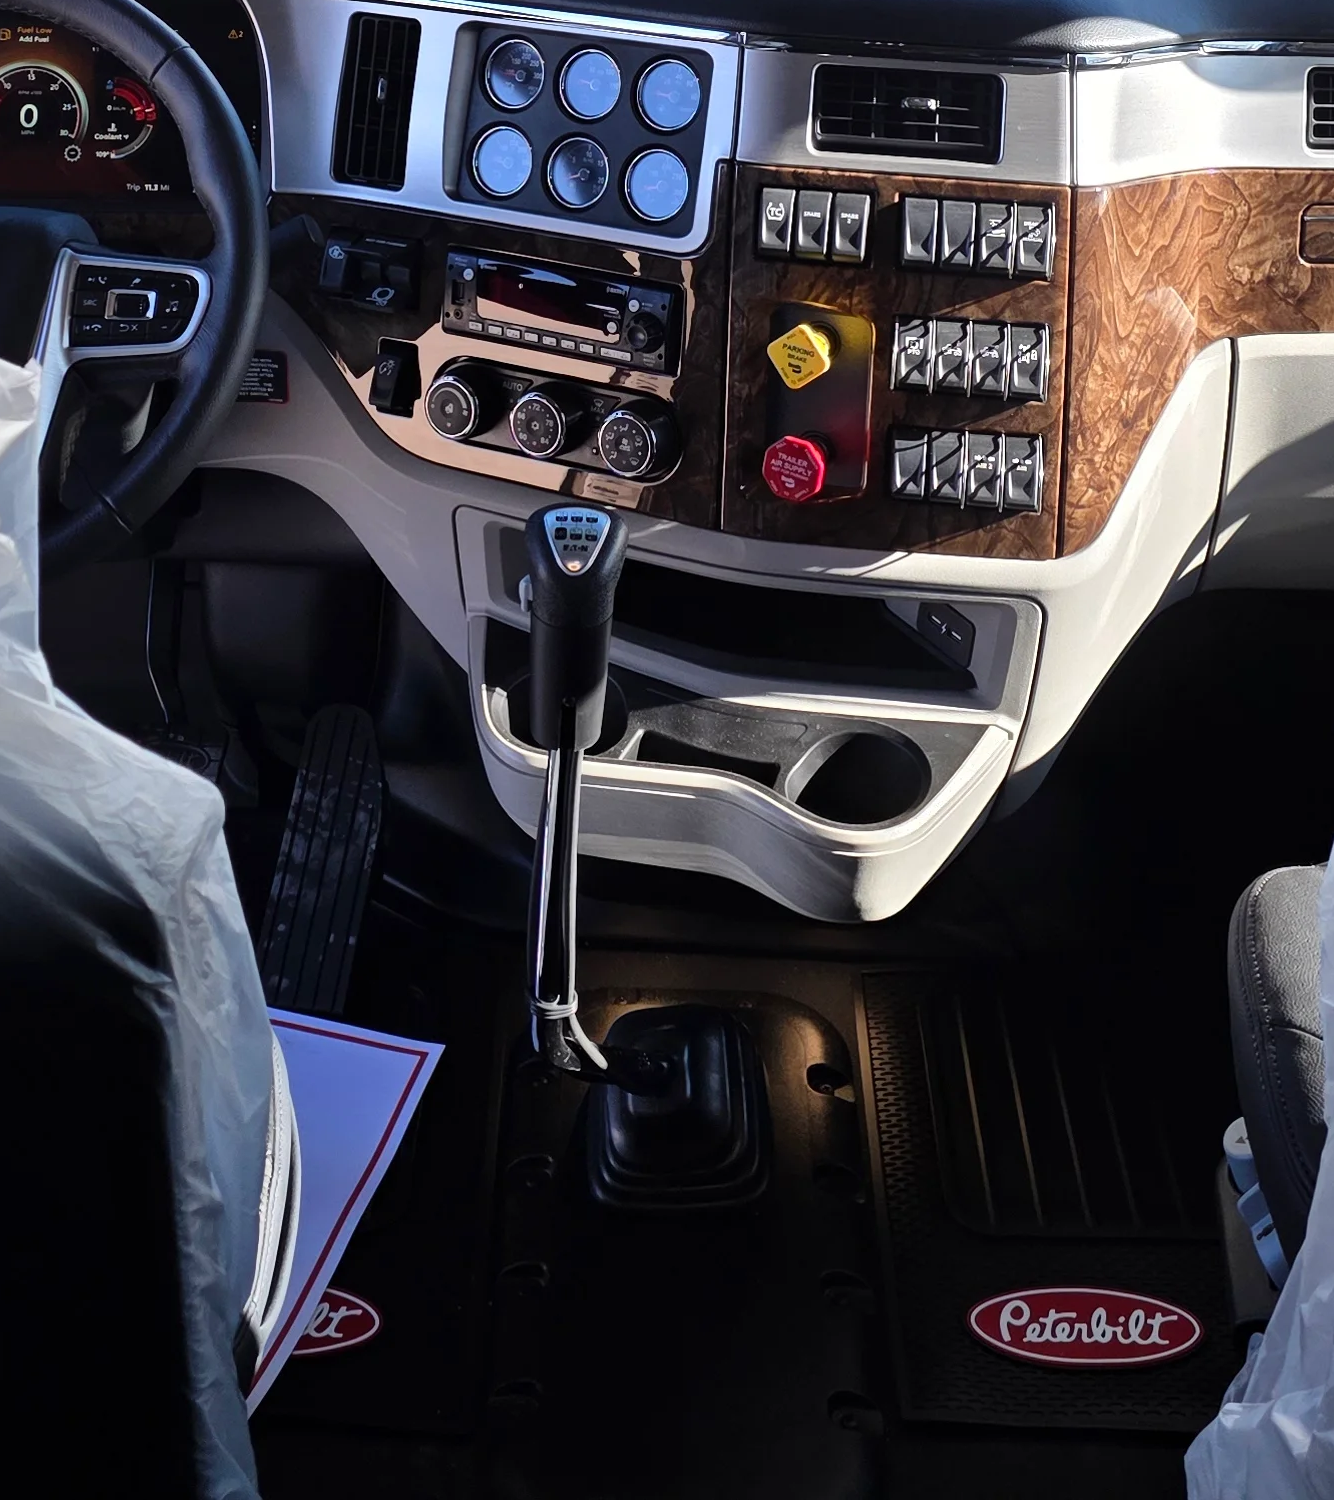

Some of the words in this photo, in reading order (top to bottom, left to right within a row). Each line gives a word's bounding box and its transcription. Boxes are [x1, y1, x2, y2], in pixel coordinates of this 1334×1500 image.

[17, 26, 34, 34] Fuel
[35, 26, 53, 34] Low
[27, 73, 36, 81] 15
[3, 82, 12, 90] 10
[49, 83, 60, 91] 20
[62, 103, 72, 111] 25
[19, 103, 39, 128] 0
[126, 184, 141, 192] Trip
[769, 207, 782, 217] TC
[782, 343, 815, 358] PARKING
[787, 353, 808, 364] BRAKE
[502, 380, 524, 393] AUTO
[531, 404, 541, 412] 72
[777, 451, 808, 468] TRAILER
[770, 458, 783, 468] AIR
[783, 462, 813, 477] SUPPLY
[999, 1299, 1179, 1346] Peterbilt
